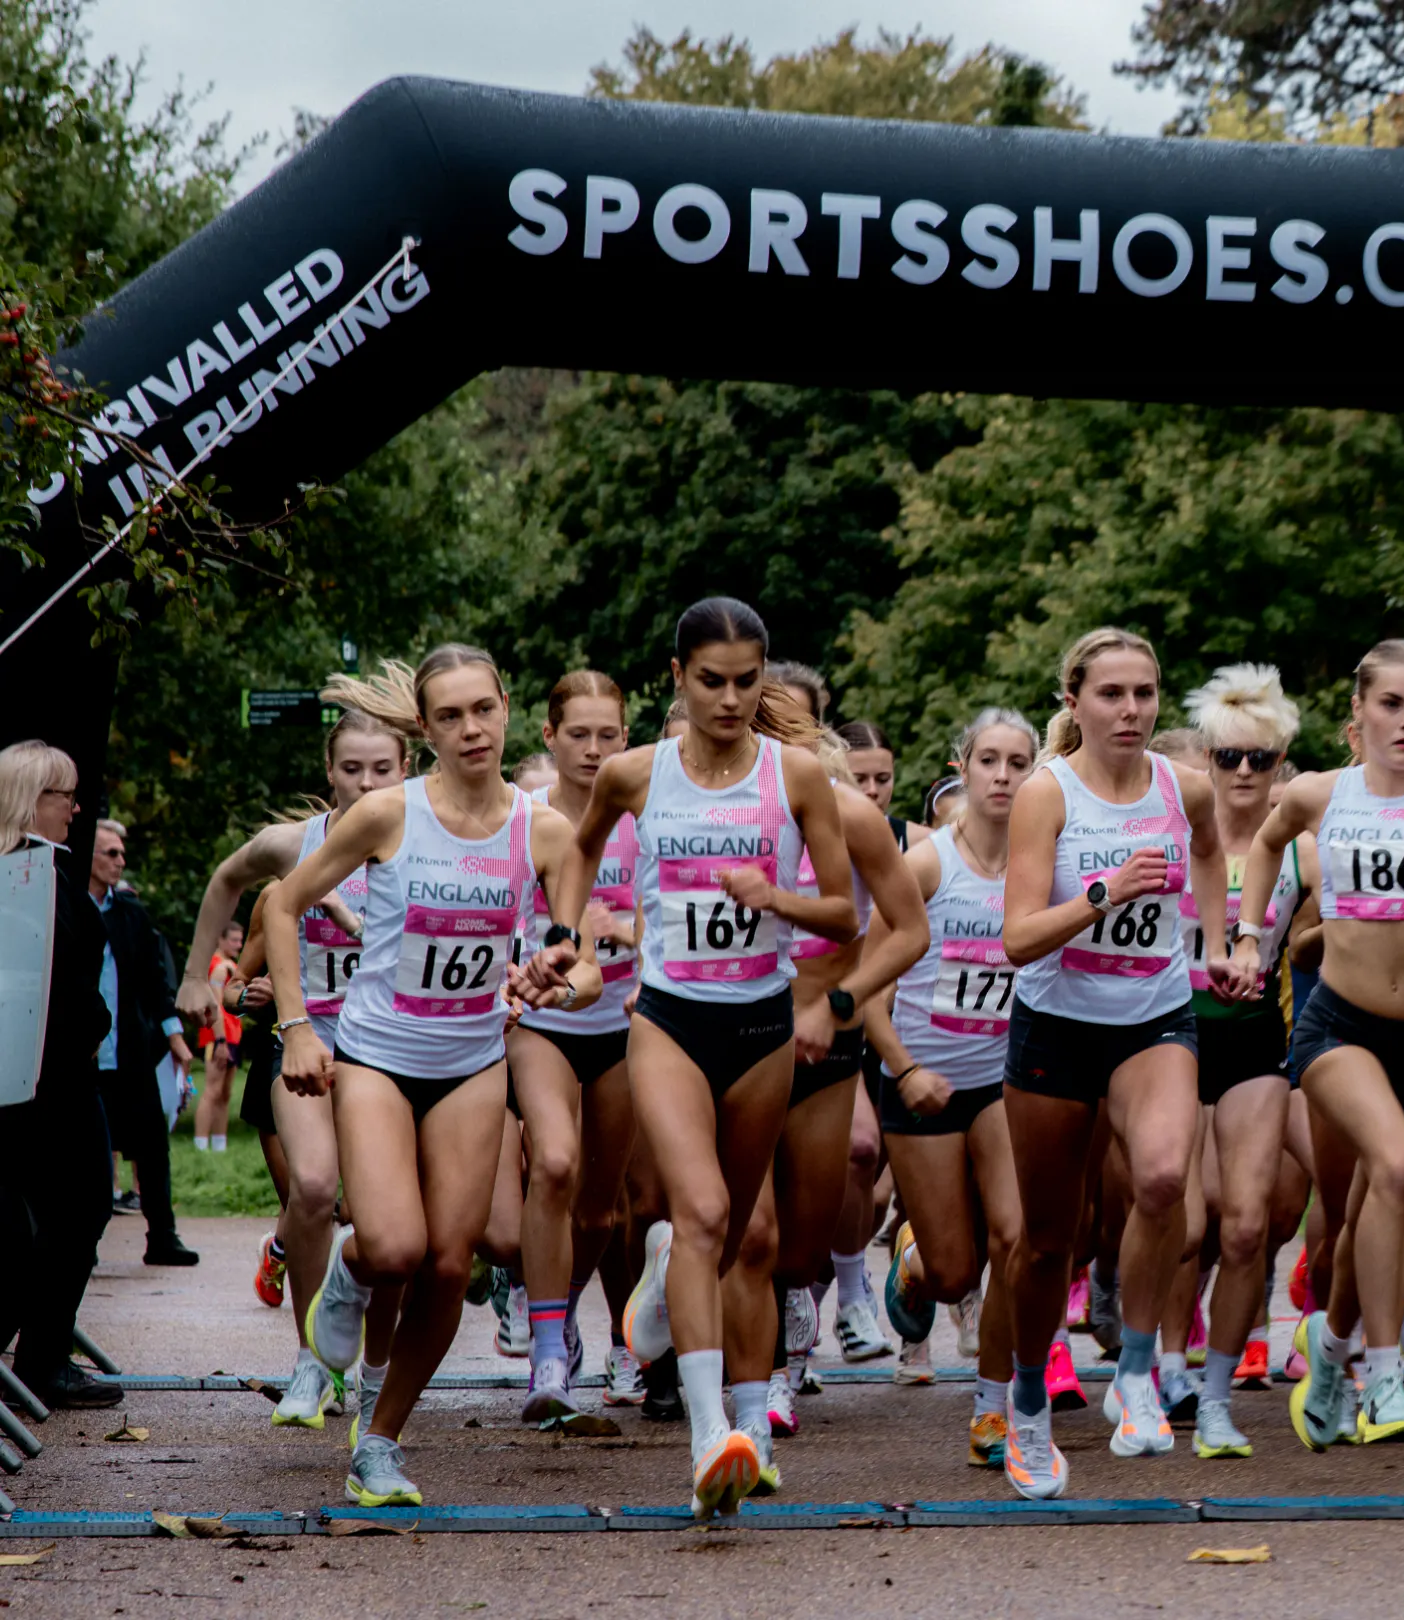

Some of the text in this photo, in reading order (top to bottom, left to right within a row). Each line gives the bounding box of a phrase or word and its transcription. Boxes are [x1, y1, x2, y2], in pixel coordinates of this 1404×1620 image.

[182, 262, 431, 463] RUNNING
[416, 856, 452, 867] KUKRI
[657, 836, 774, 856] ENGLAND
[408, 880, 516, 908] ENGLAND
[686, 902, 762, 951] 169
[1091, 902, 1162, 948] 168
[326, 952, 360, 993] 19
[421, 944, 494, 991] 162
[955, 968, 1015, 1012] 177
